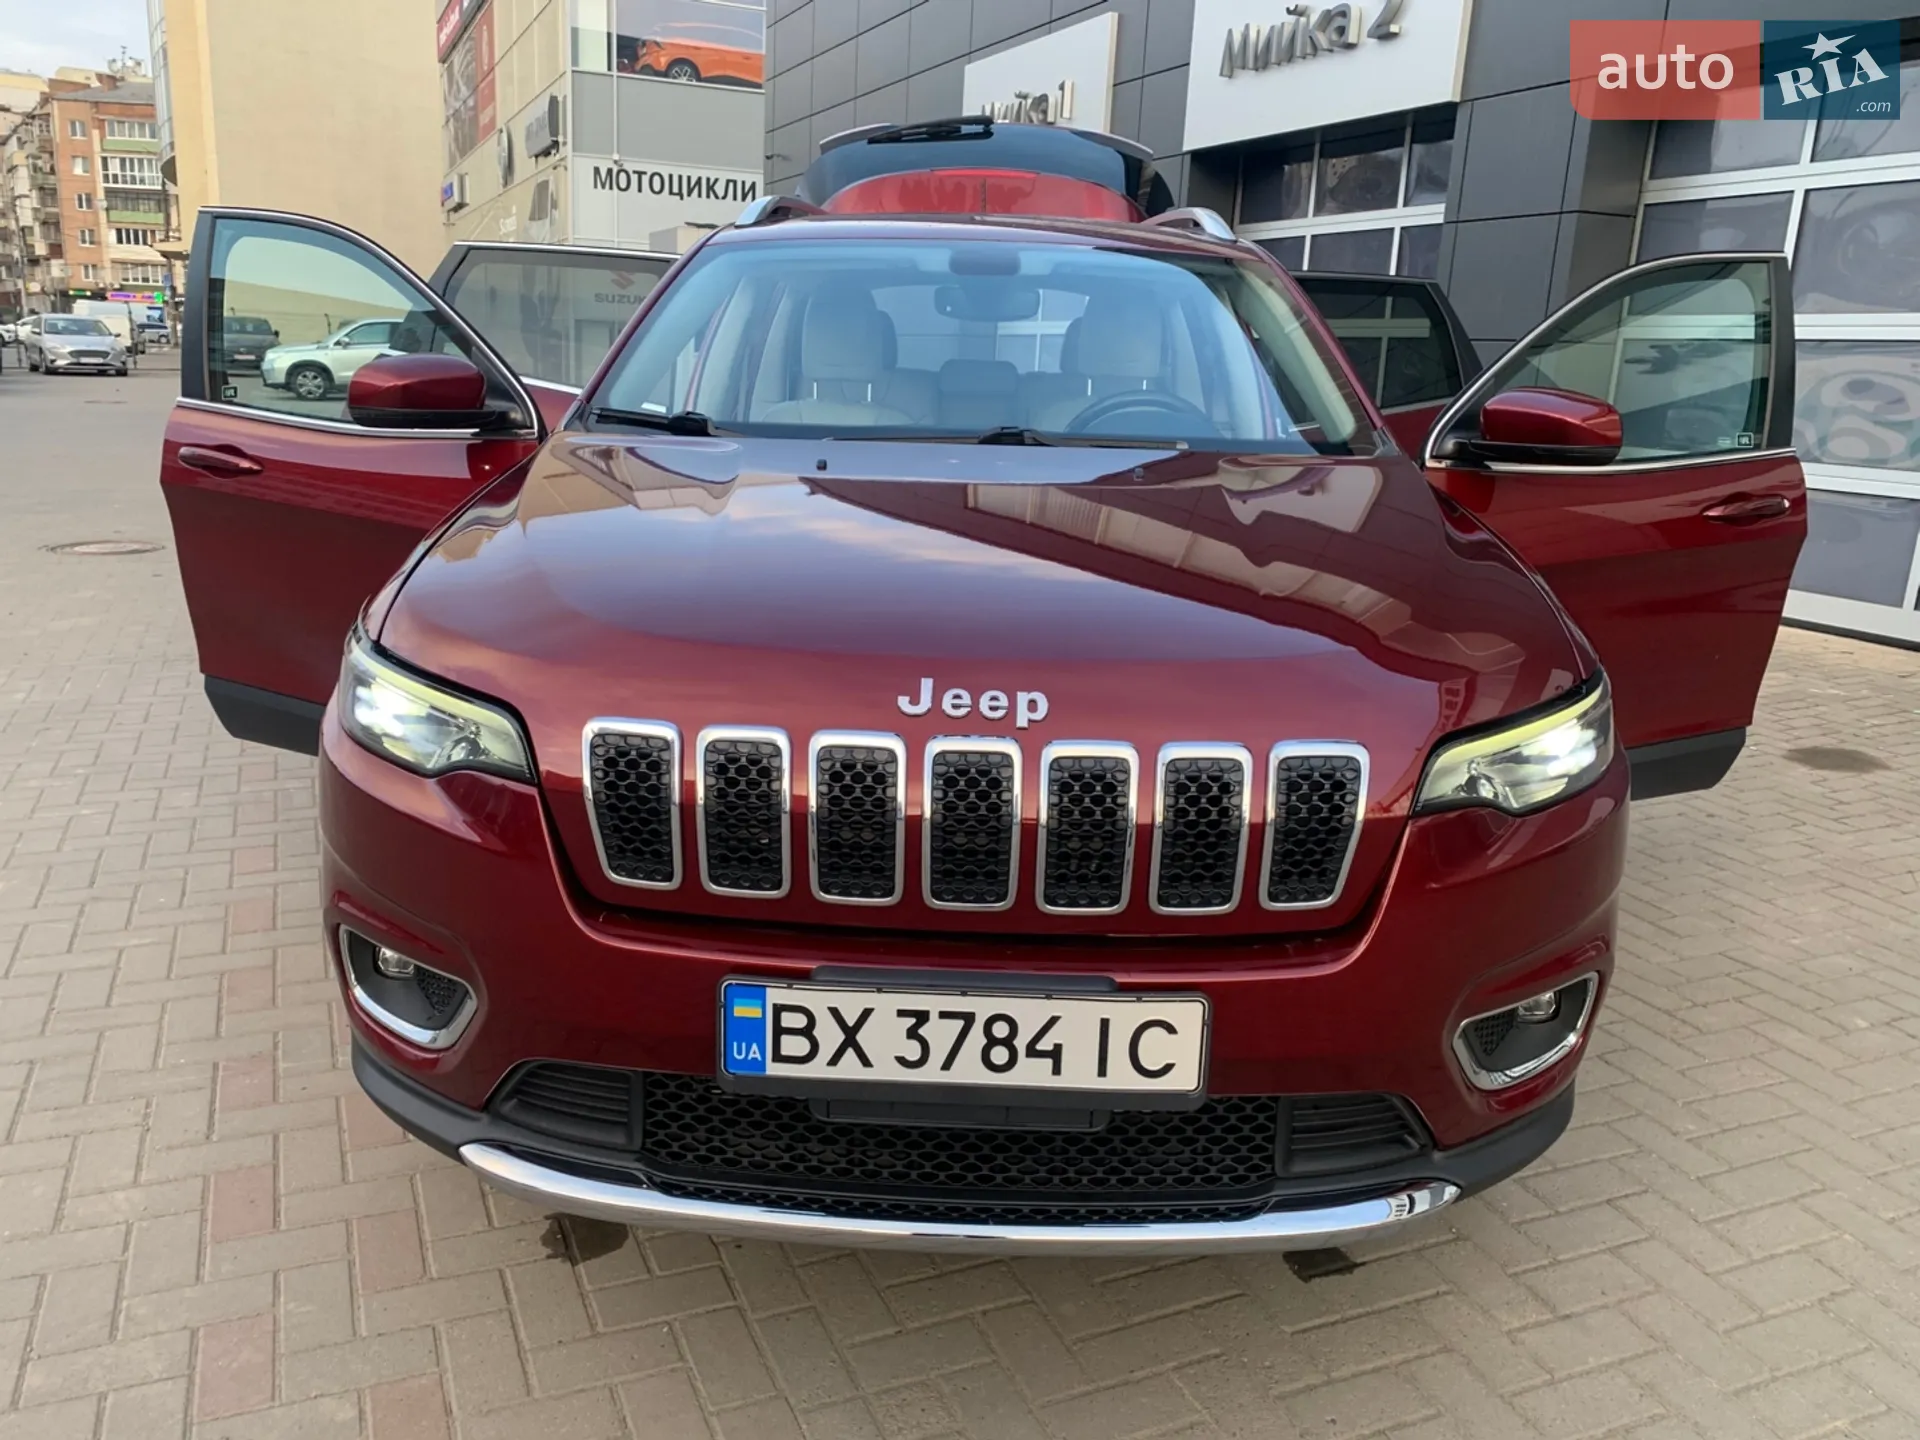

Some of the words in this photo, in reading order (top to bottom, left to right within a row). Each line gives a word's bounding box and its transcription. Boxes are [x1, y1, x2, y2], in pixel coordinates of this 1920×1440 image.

[593, 165, 757, 203] МОТОЦИКЛИ
[594, 292, 647, 306] SUZUK
[897, 677, 1049, 730] Jeep
[733, 1041, 762, 1062] UA
[771, 1003, 874, 1069] BX
[893, 1009, 1063, 1077] 3784
[1097, 1017, 1178, 1079] IC
